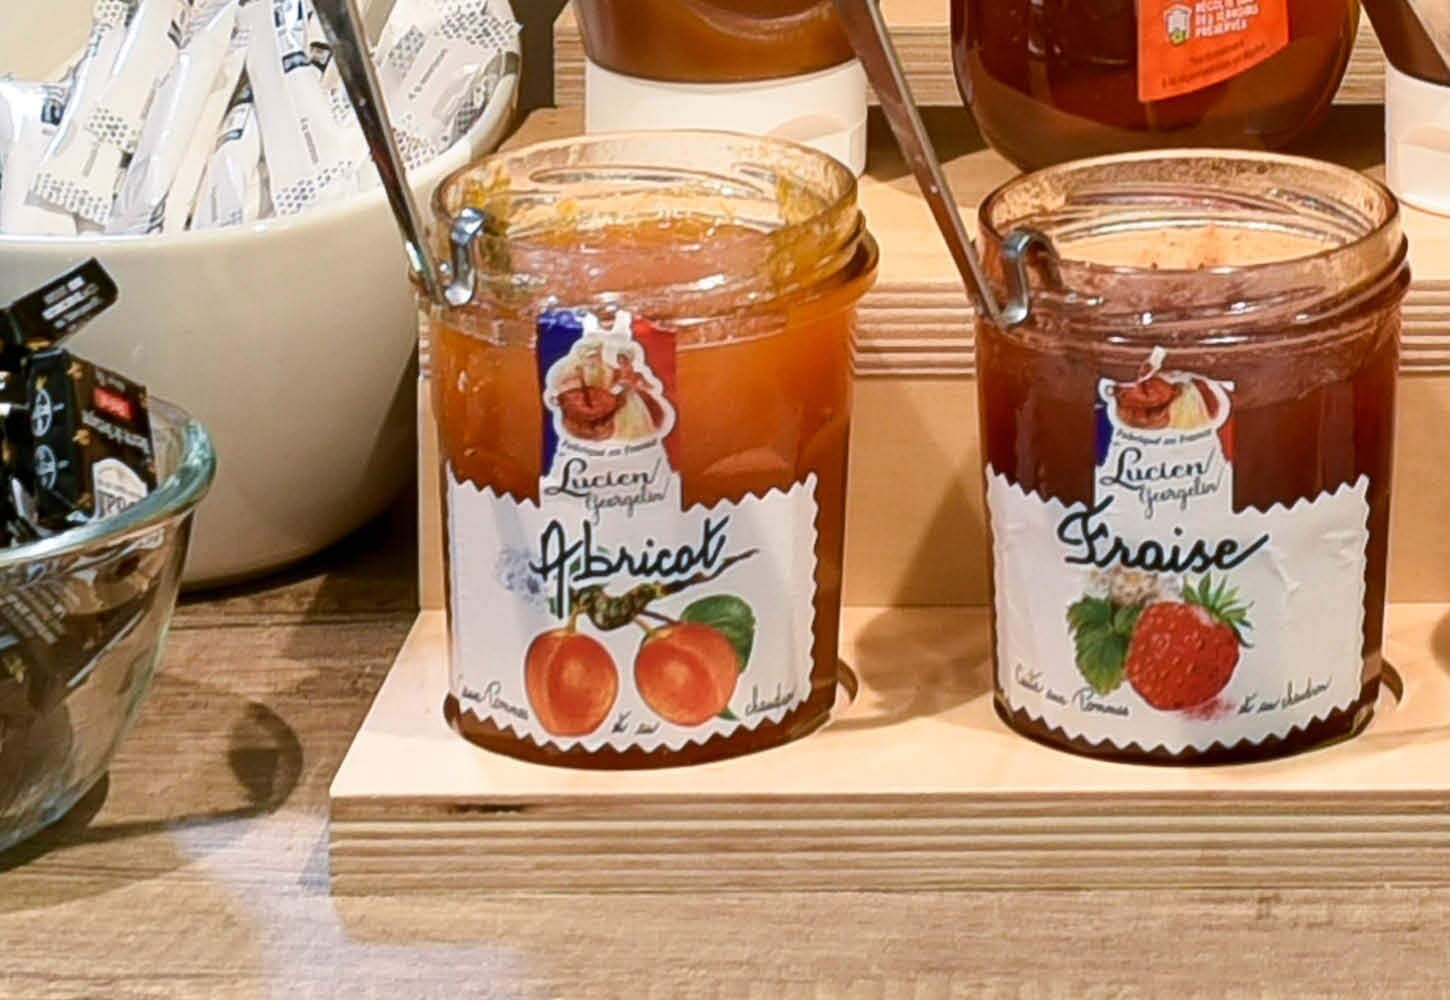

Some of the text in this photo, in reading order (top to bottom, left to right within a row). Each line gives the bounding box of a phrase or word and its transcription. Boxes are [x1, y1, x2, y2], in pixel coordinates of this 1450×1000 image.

[543, 456, 662, 498] Lucien
[1099, 445, 1217, 491] Lucien
[1056, 495, 1270, 574] Fraise
[529, 515, 729, 620] Abricot
